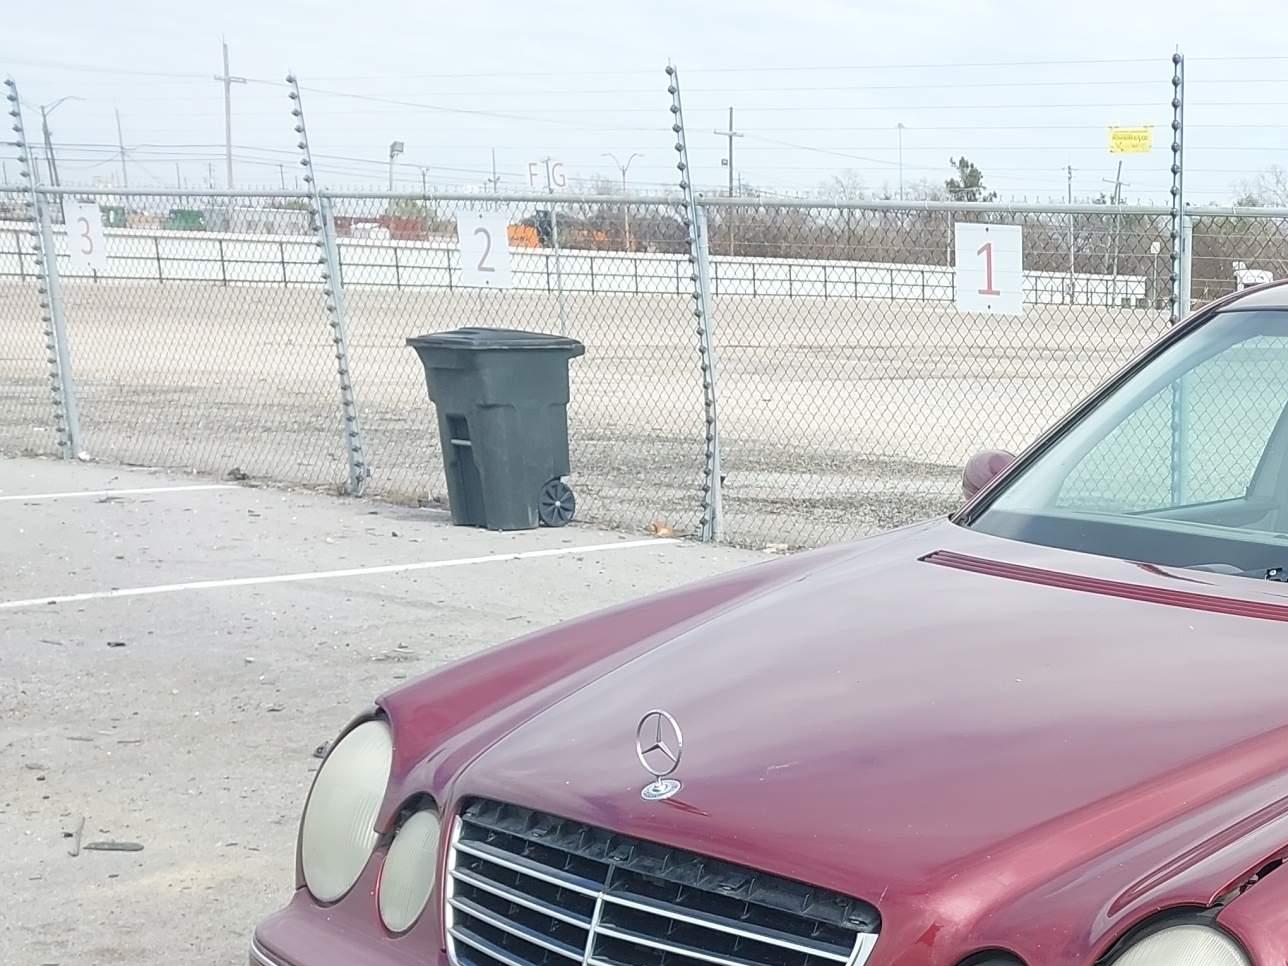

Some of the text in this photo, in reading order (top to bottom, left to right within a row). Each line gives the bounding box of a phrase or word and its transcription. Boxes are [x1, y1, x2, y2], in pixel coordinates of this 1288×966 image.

[551, 162, 566, 188] G
[77, 216, 94, 255] 3
[473, 227, 496, 273] 2
[976, 242, 1001, 296] 1
